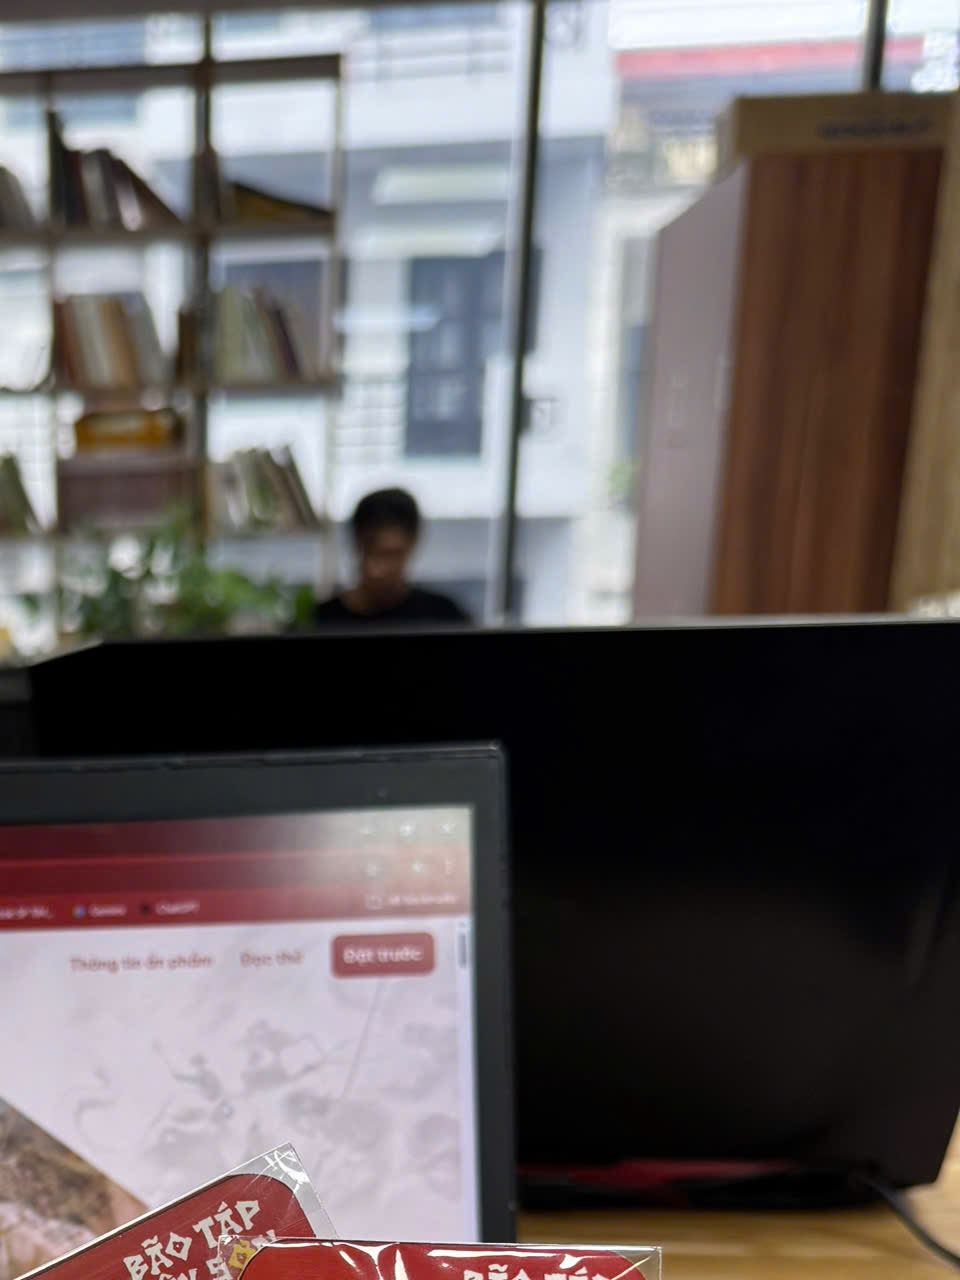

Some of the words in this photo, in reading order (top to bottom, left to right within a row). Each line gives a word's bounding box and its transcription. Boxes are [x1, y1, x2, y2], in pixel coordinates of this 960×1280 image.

[122, 955, 141, 970] tin
[343, 945, 372, 966] Đặt
[193, 1199, 262, 1252] TÁP
